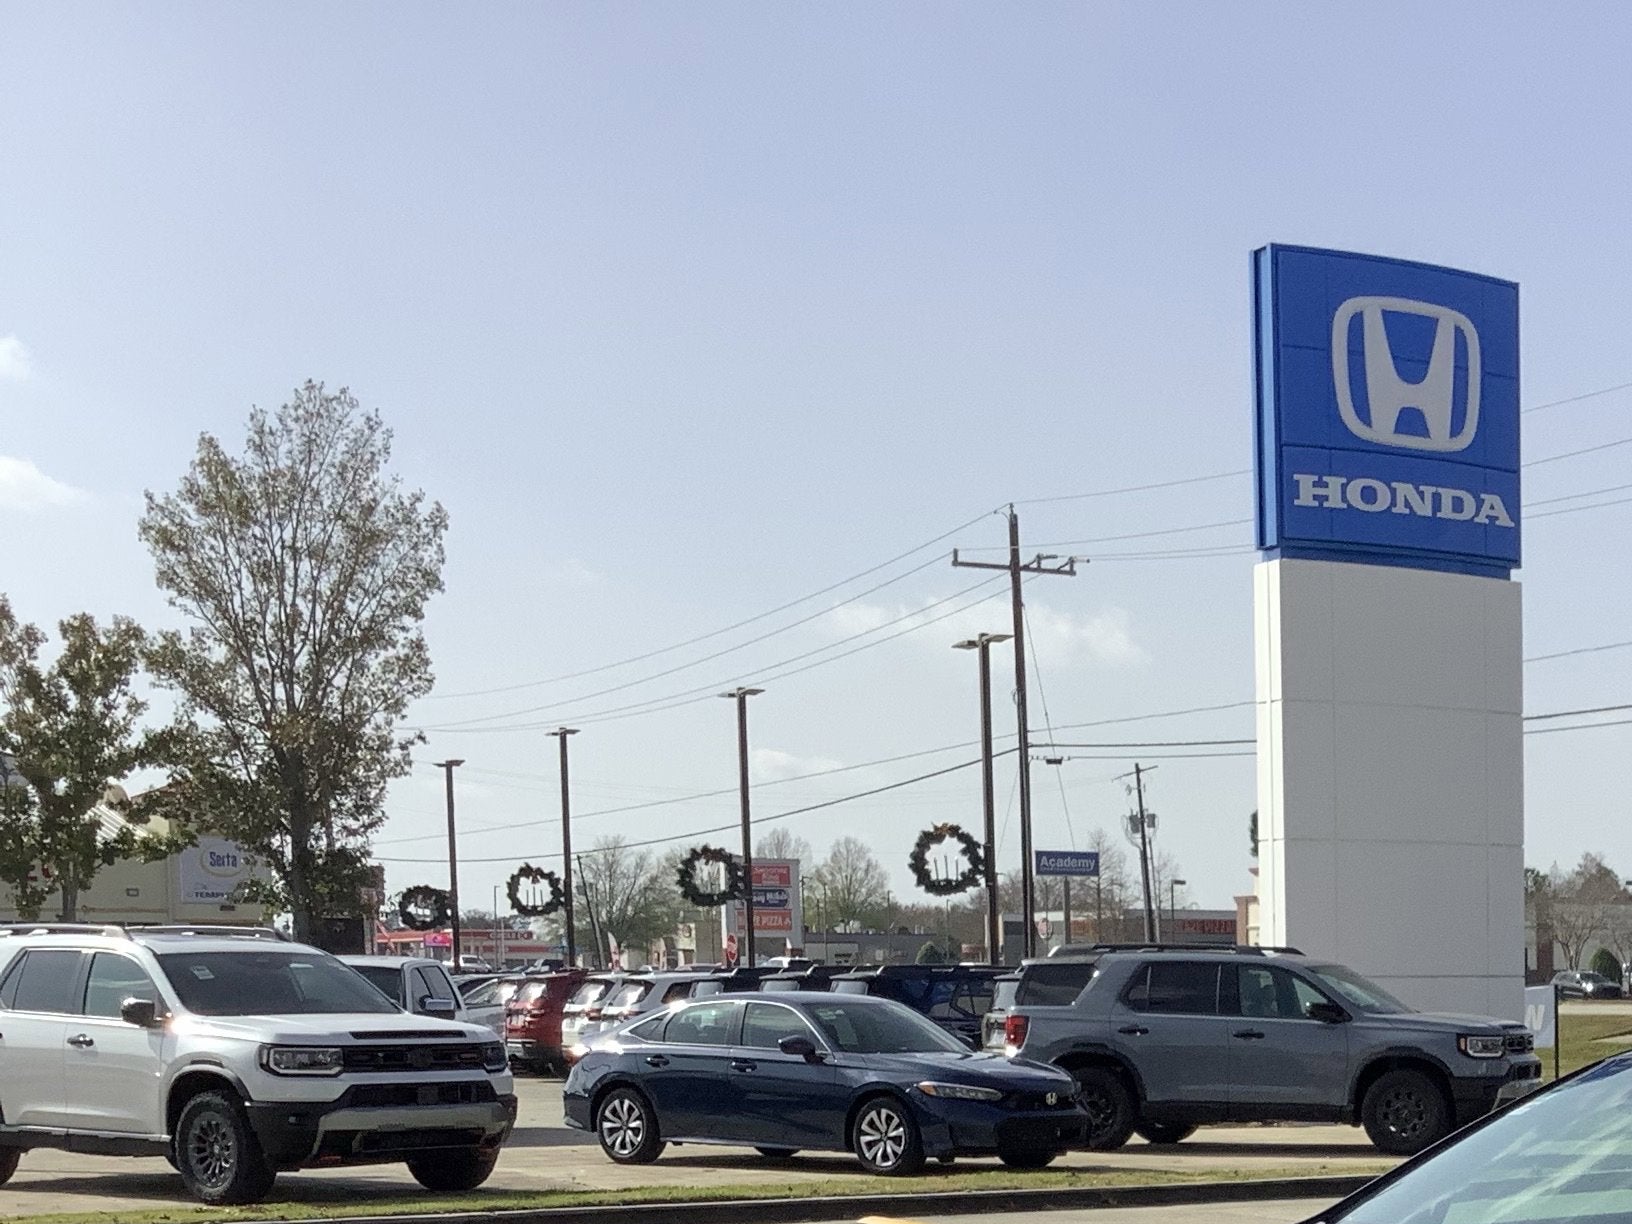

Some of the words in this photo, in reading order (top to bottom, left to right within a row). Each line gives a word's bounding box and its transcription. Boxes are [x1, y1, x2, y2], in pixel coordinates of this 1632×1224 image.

[1293, 473, 1515, 528] HONDA
[209, 851, 238, 868] Serta
[1040, 855, 1096, 871] Academy
